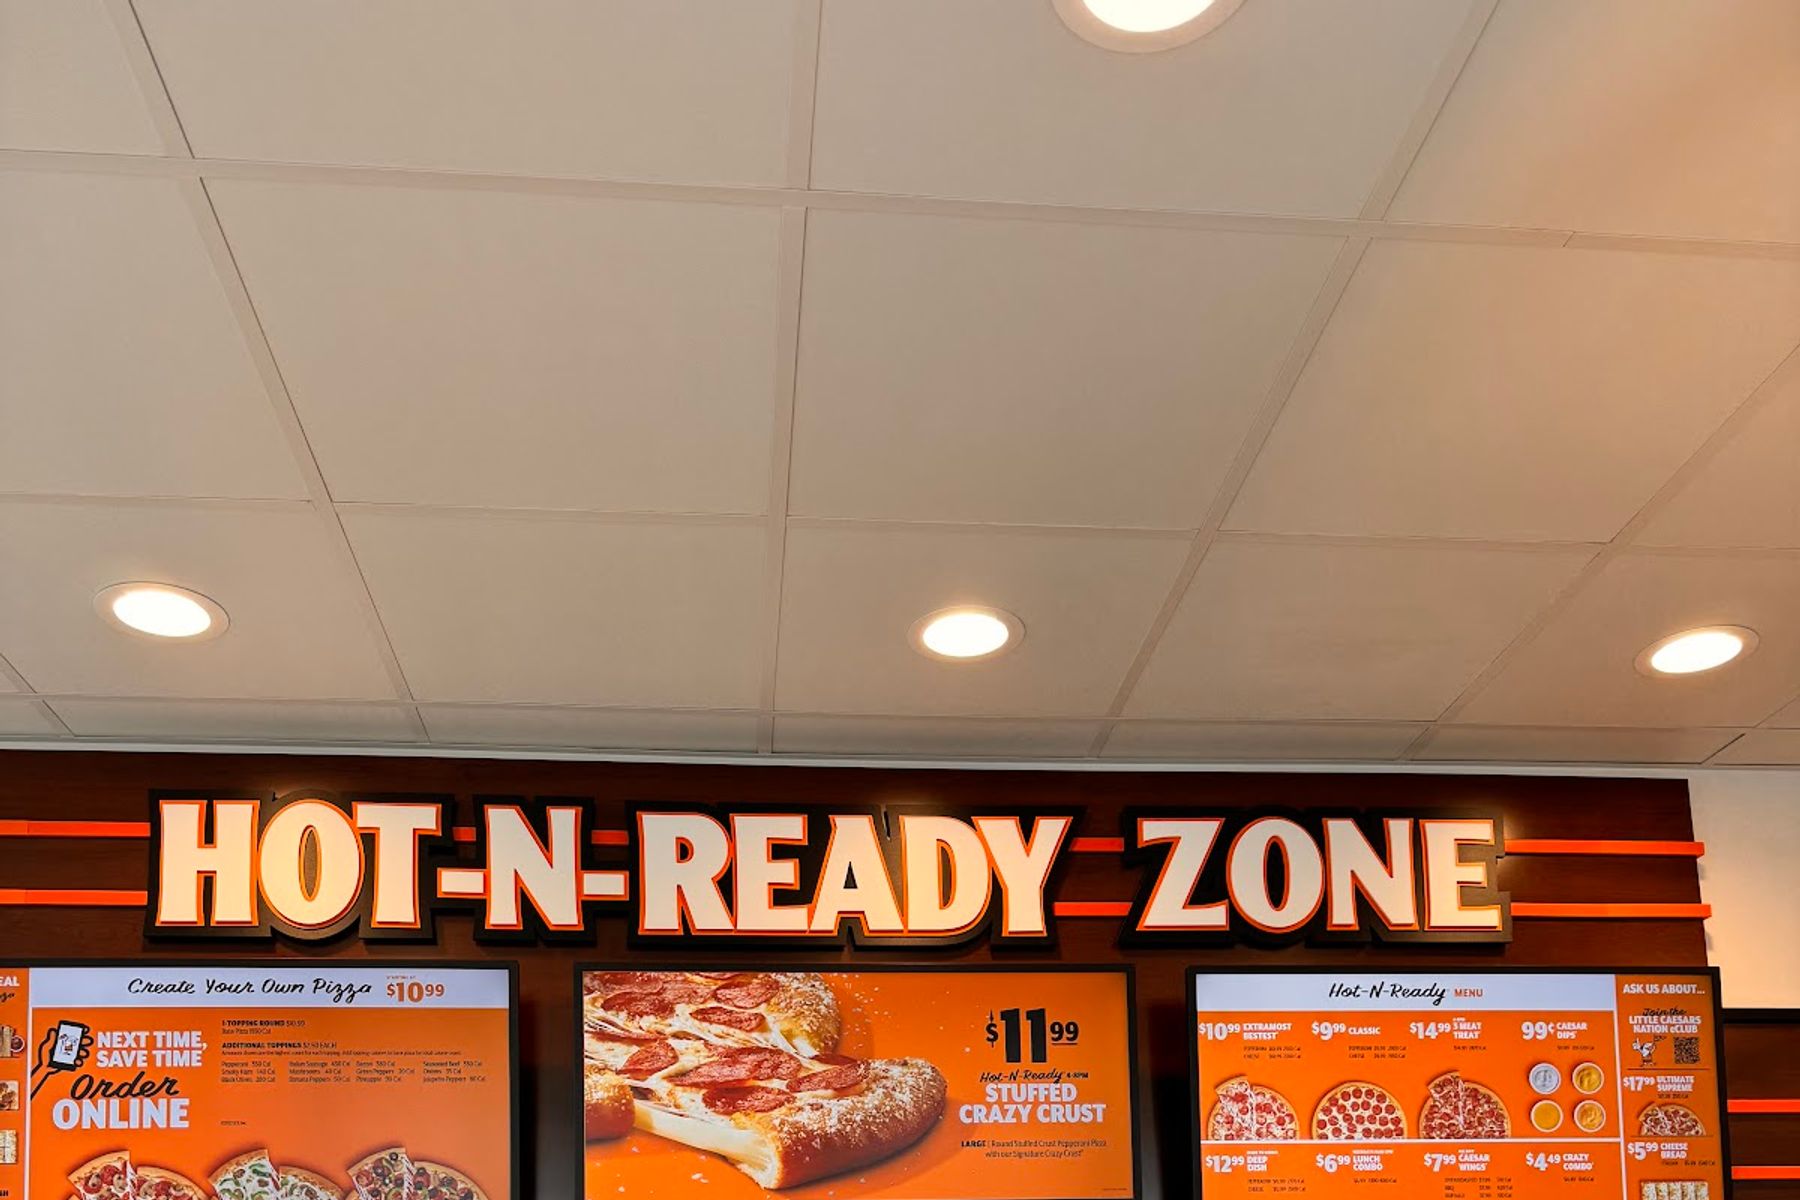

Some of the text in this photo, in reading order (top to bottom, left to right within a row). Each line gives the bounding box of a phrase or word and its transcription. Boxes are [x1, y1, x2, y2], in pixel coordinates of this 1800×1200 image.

[1136, 816, 1502, 933] ZONE
[128, 978, 195, 993] Create
[205, 979, 254, 993] Your
[262, 980, 305, 993] Own
[313, 978, 372, 1003] Pizza
[1328, 981, 1483, 1006] Hot-N-Ready MENU
[1623, 984, 1644, 994] ASK
[1645, 984, 1659, 994] US
[1629, 1015, 1701, 1025] LITTLE CAESARS
[1243, 1022, 1292, 1031] EXTRAMOST
[1348, 1027, 1381, 1035] CLASSIC
[1459, 1022, 1482, 1031] MEAT
[1556, 1022, 1588, 1031] CAESAR
[1633, 1025, 1668, 1033] NATION
[1243, 1032, 1279, 1040] BESTEST
[1453, 1031, 1480, 1039] TREAT
[1556, 1031, 1576, 1039] DIPS
[97, 1031, 207, 1050] NEXT TIME,
[96, 1051, 148, 1067] SAVE
[153, 1051, 202, 1067] TIME
[980, 1068, 1063, 1084] Hot-N-Ready
[1656, 1075, 1694, 1084] ULTIMATE
[70, 1071, 179, 1100] Order
[1657, 1083, 1693, 1092] SUPREME
[985, 1083, 1077, 1103] STUFFED
[53, 1098, 190, 1129] ONLINE
[959, 1104, 1106, 1123] CRAZY CRUST
[1057, 1140, 1089, 1149] Pepperoni
[1091, 1139, 1106, 1147] Pizza
[1660, 1142, 1688, 1151] CHEESE
[1353, 1155, 1380, 1164] LUNCH
[1458, 1154, 1490, 1162] CAESAR
[1562, 1154, 1589, 1162] CRAZY
[1660, 1151, 1687, 1159] BREAD
[1246, 1156, 1268, 1164] DEEP
[1247, 1164, 1267, 1172] DISH
[1353, 1163, 1383, 1172] COMBO
[1458, 1163, 1487, 1171] WINGS
[1563, 1162, 1592, 1171] COMBO
